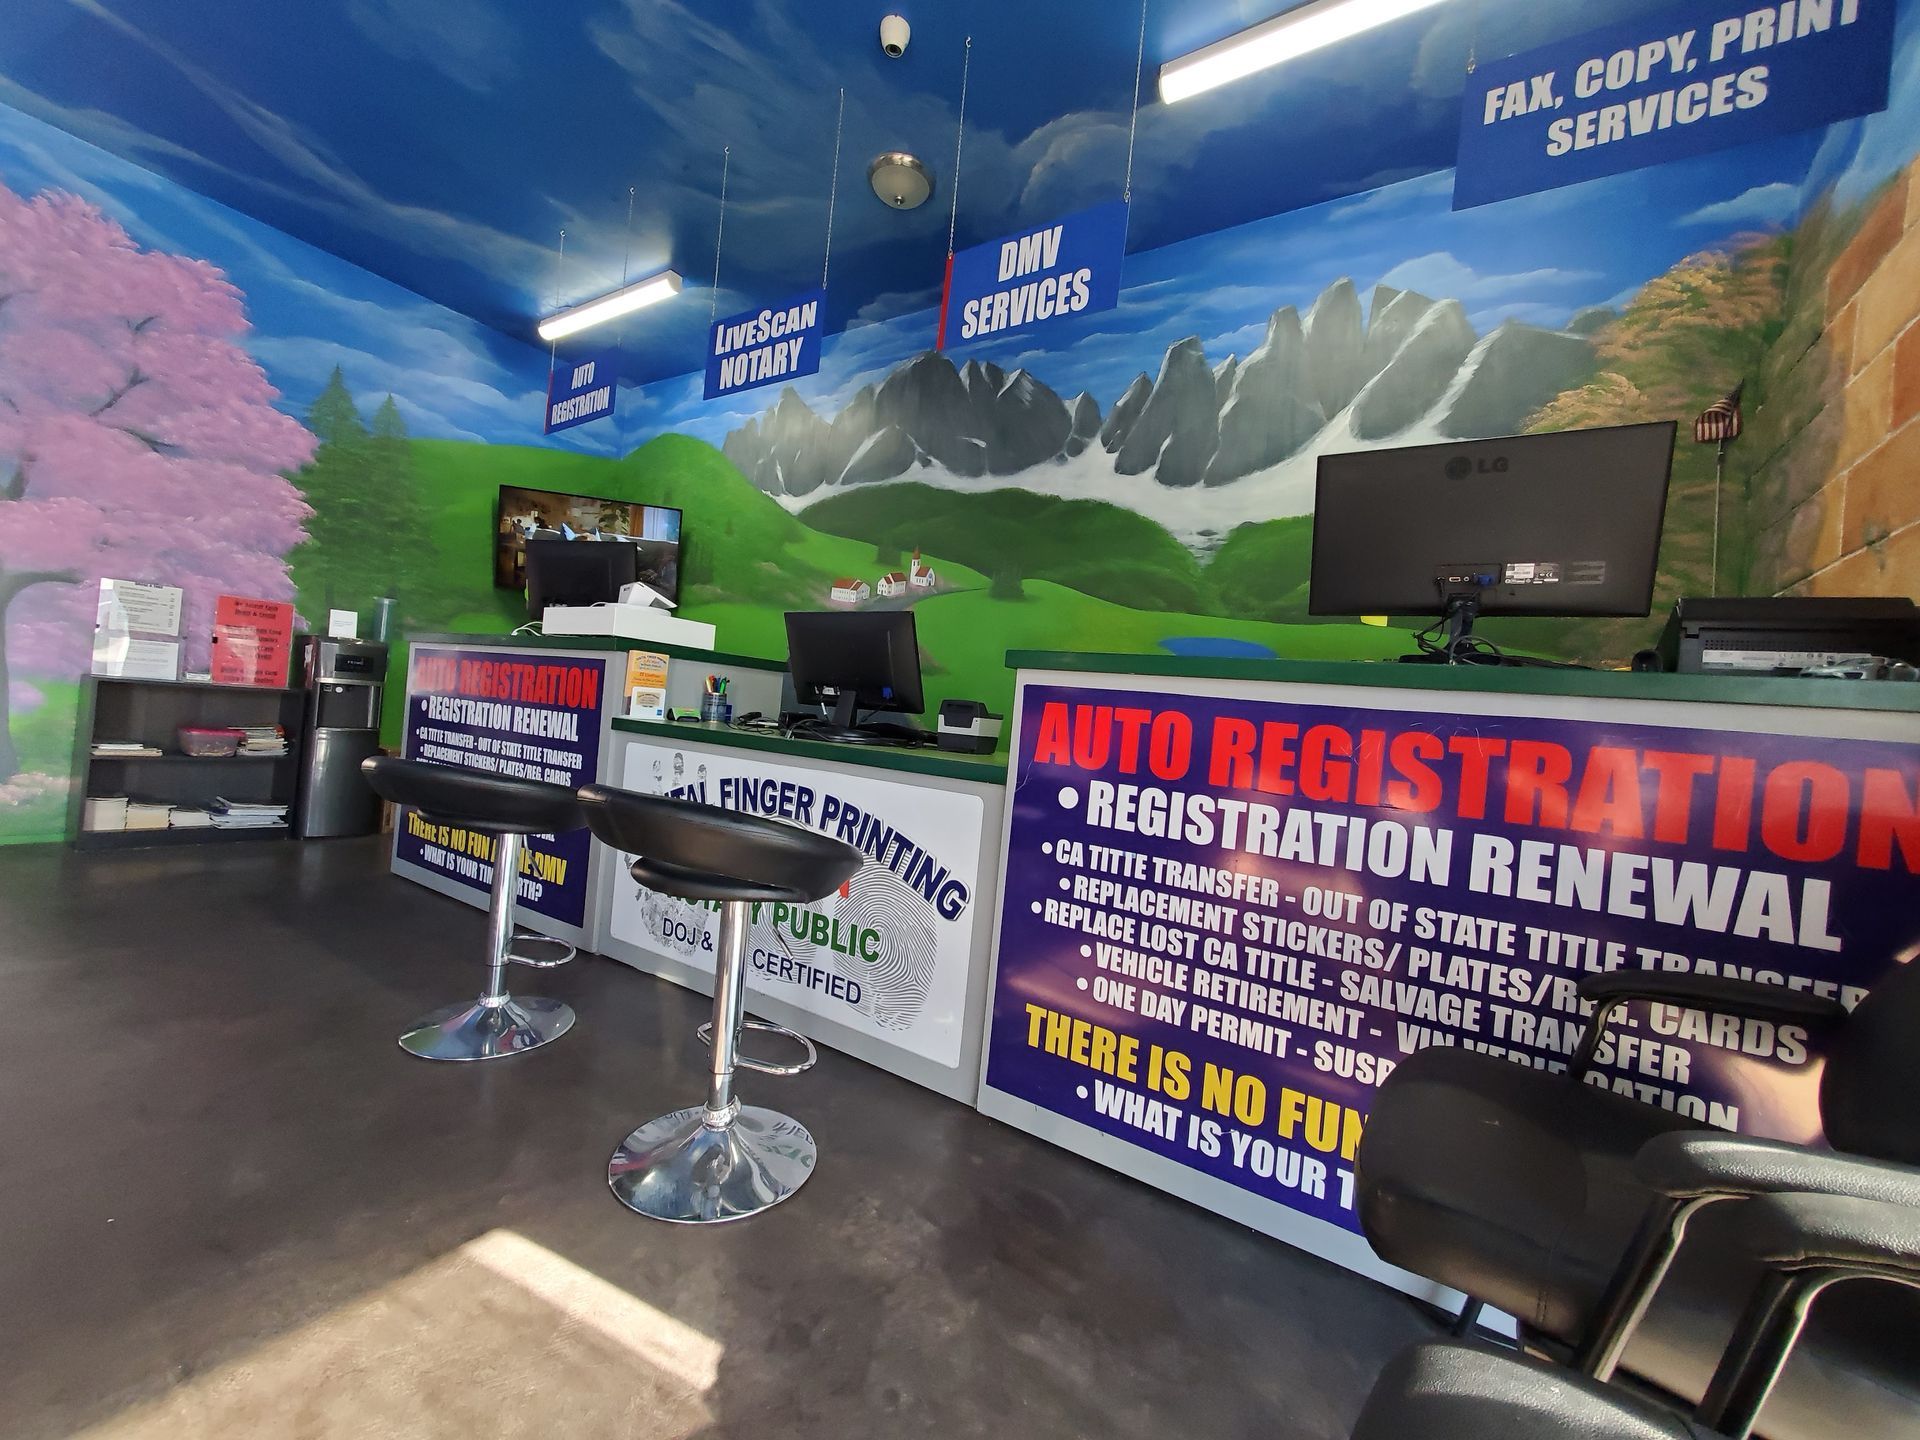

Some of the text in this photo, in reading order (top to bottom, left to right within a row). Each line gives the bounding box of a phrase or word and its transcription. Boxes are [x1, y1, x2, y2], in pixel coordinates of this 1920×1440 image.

[1483, 0, 1859, 125] FAX, COPY, PRINT
[1546, 66, 1769, 157] SERVICES
[998, 225, 1064, 282] DMV
[961, 268, 1091, 339] SERVICES
[571, 361, 595, 390] AUTO
[719, 337, 803, 390] NOTARY
[551, 386, 610, 426] REGISTRATION
[1477, 456, 1509, 474] LG
[416, 656, 457, 692] AUTO
[460, 660, 598, 710] REGISTRATION
[420, 726, 428, 740] CA
[444, 730, 475, 749] TRANSFER
[478, 737, 492, 752] OUT
[492, 740, 501, 754] OF
[501, 741, 522, 759] STATE
[522, 744, 542, 762] TITLE
[543, 748, 583, 770] TRANSFER
[428, 696, 578, 742] REGISTRATION RENEWAL
[424, 743, 464, 764] REPLACEMENT
[464, 751, 499, 772] STICKERS/
[499, 759, 543, 781] PLATES/REG.
[544, 767, 571, 787] CARDS
[1034, 702, 1920, 874] AUTO REGISTRATION
[424, 844, 446, 867] WHAT
[446, 852, 455, 871] IS
[456, 854, 477, 879] YOUR
[438, 826, 449, 847] IS
[450, 828, 466, 851] NO
[467, 832, 490, 860] FUN
[534, 851, 567, 885] DMV
[719, 776, 971, 921] FINGER PRINTING
[1086, 780, 1842, 953] REGISTRATION RENEWAL
[662, 917, 713, 952] DOJ &
[773, 901, 880, 962] PUBLIC
[1056, 839, 1083, 868] CA
[1152, 856, 1279, 907] TRANSFER
[1285, 895, 1296, 903] -
[1302, 886, 1363, 924] OUT
[1368, 899, 1409, 933] OF
[1414, 907, 1517, 956] STATE
[1525, 926, 1626, 974] TITLE
[752, 948, 861, 1005] CERTIFIED
[1044, 898, 1691, 1084] REPLACE LOST CA TITLE - SALVAGE TRANSFER
[1073, 874, 1238, 935] REPLACEMENT
[1242, 911, 1402, 972] STICKERS/
[1650, 1001, 1808, 1065] CARDS
[1096, 941, 1188, 991] VEHICLE
[1192, 967, 1364, 1040] RETIREMENT
[1369, 1028, 1382, 1037] -
[1093, 976, 1136, 1012] ONE
[1140, 990, 1187, 1027] DAY
[1190, 1004, 1292, 1058] PERMIT
[1296, 1047, 1308, 1056] -
[1025, 1003, 1368, 1162] THERE IS NO FUN
[1094, 1079, 1182, 1142] WHAT
[1187, 1114, 1222, 1158] IS
[1231, 1129, 1327, 1200] YOUR
